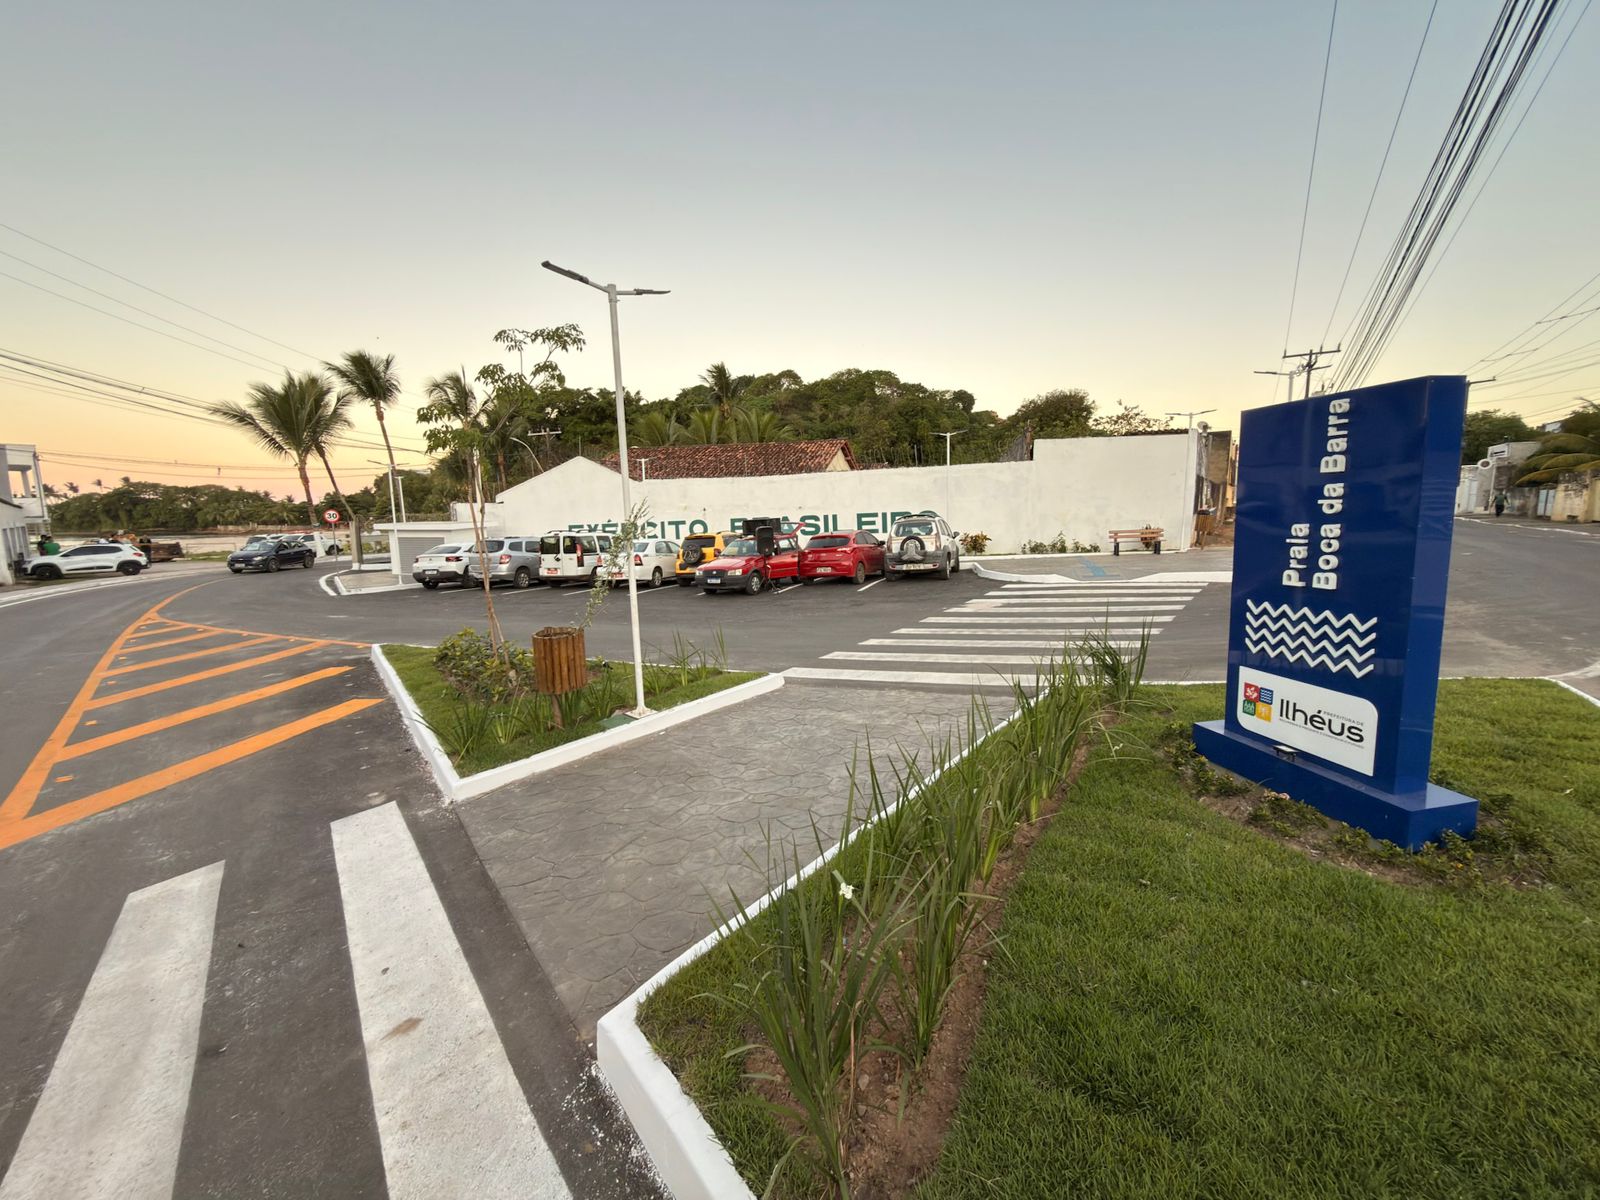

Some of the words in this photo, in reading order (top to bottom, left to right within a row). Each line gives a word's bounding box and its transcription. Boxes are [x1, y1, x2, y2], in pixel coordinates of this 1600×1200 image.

[1320, 398, 1350, 473] Barra
[327, 512, 337, 520] 30
[1317, 482, 1344, 515] da
[568, 518, 709, 540] ÉCITO
[730, 510, 940, 536] BASILEI
[1282, 523, 1310, 587] Praia
[1312, 523, 1341, 590] Boca
[1279, 698, 1365, 743] Ilhéus
